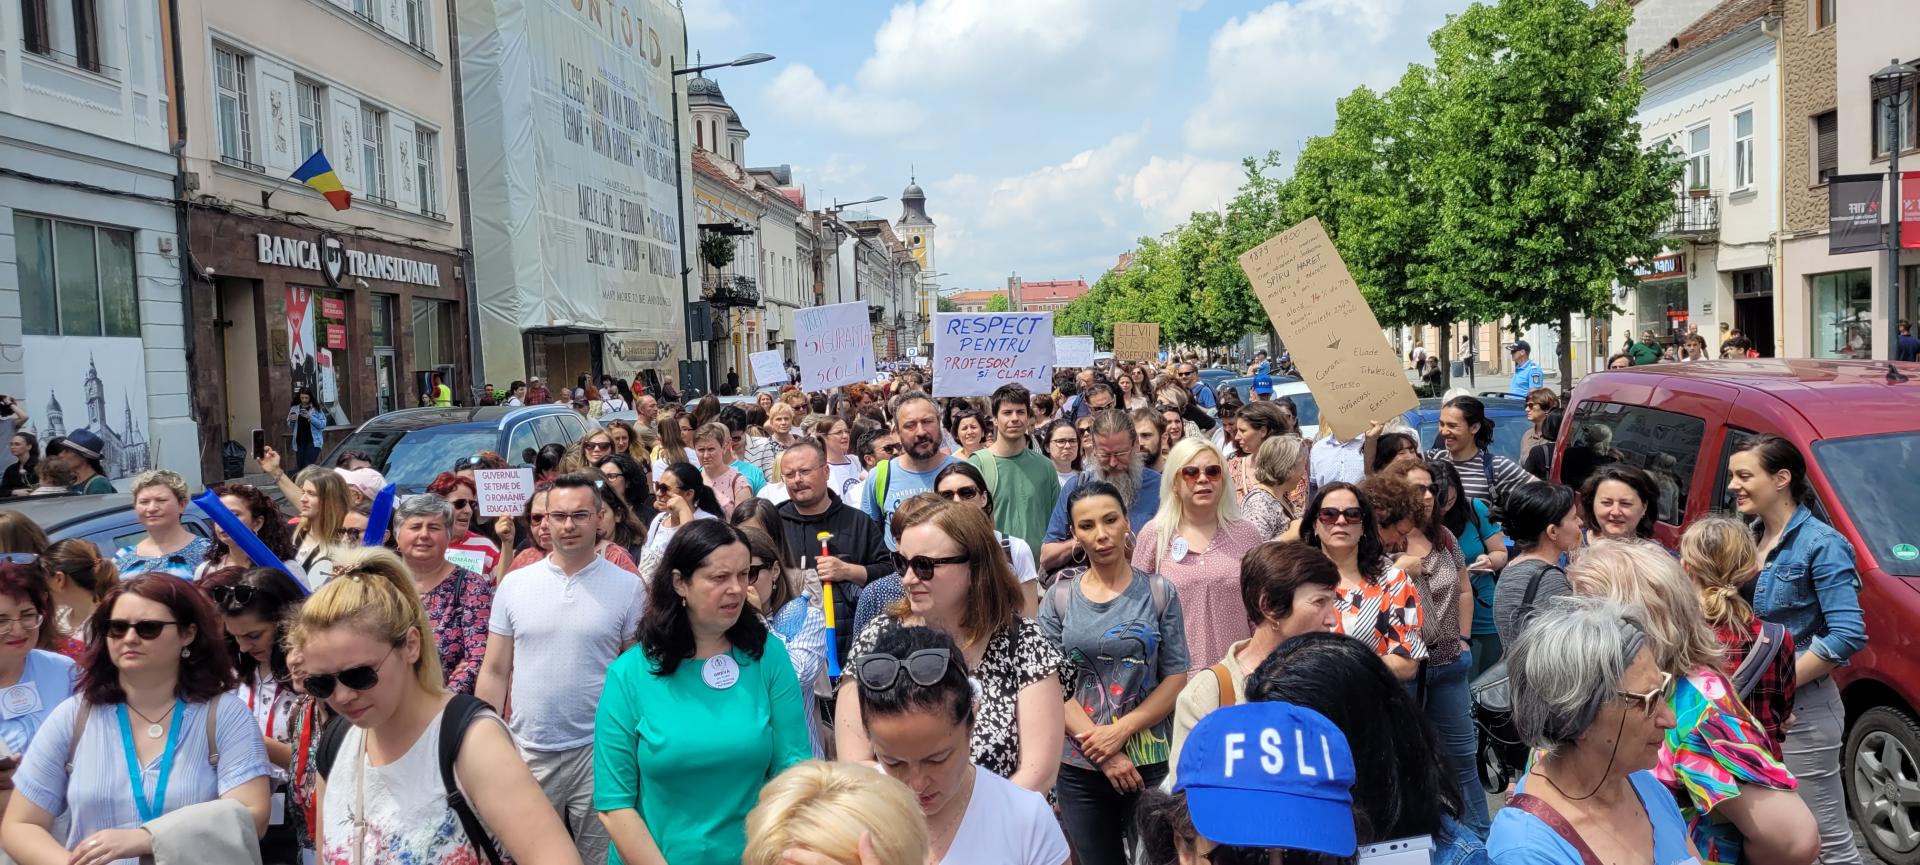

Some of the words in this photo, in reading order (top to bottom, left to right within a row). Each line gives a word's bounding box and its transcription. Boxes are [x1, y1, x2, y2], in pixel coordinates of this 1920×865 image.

[257, 233, 321, 271] BANCA
[346, 250, 440, 287] TRANSILVANIA
[1296, 254, 1321, 272] HARET
[602, 289, 616, 300] MANY
[617, 290, 631, 303] MORE
[1311, 293, 1320, 303] 14
[946, 316, 1044, 335] RESPECT
[1119, 323, 1151, 337] ELEVII
[960, 337, 1031, 353] PENTRU
[944, 355, 1018, 370] PROFESORI
[997, 367, 1036, 379] CLASĂ
[1038, 365, 1046, 379] !
[1360, 364, 1398, 378] Titulescu
[1329, 381, 1361, 391] Ionesco
[482, 470, 521, 479] GUVERNUL
[483, 482, 491, 491] SE
[493, 482, 510, 490] TEME
[511, 482, 521, 490] DE
[485, 494, 491, 502] O
[1224, 727, 1335, 780] FSLI
